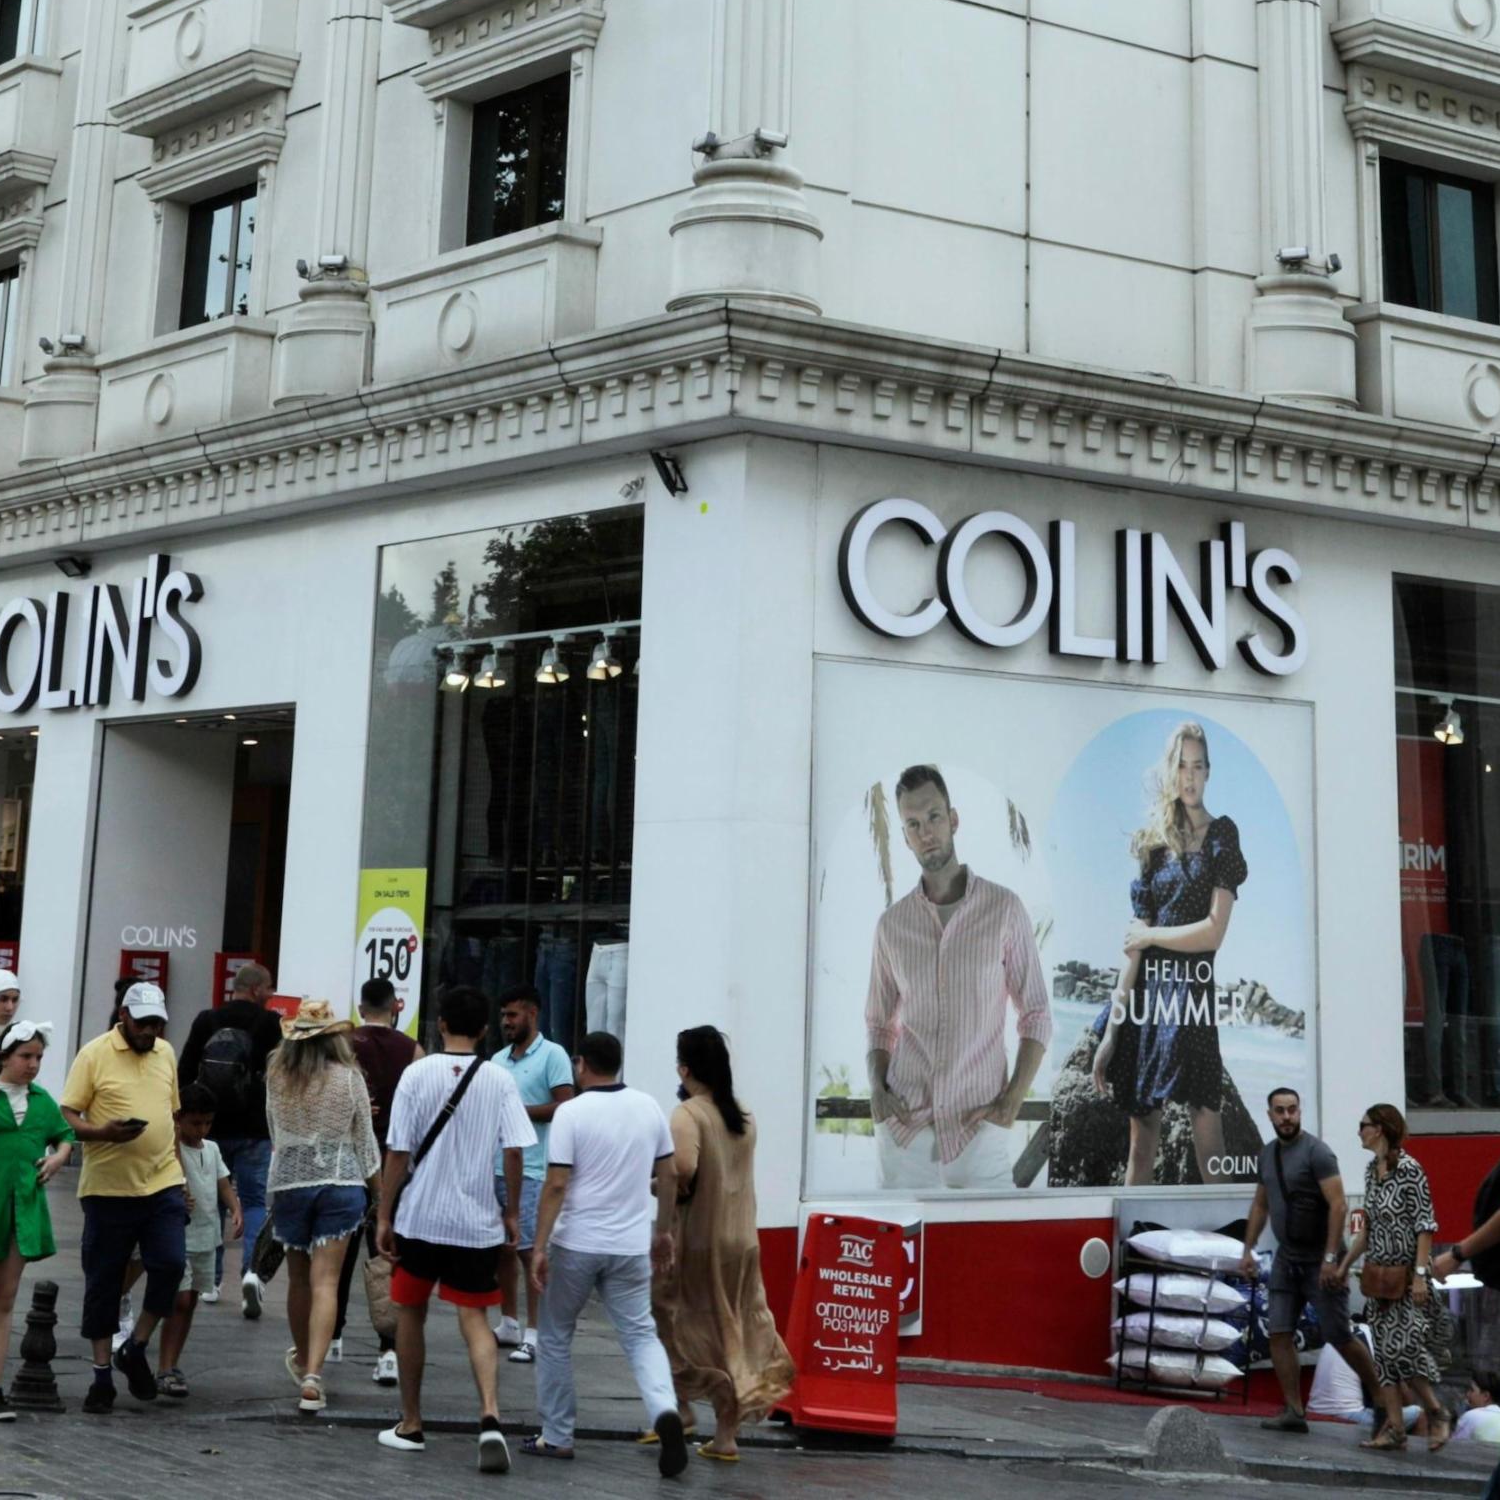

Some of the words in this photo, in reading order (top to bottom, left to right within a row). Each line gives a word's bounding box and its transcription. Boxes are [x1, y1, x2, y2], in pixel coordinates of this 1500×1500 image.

[838, 498, 1307, 676] COLIN'S
[121, 925, 197, 948] COLIN'S
[1145, 959, 1213, 983] HELLO
[1110, 989, 1247, 1027] SUMMER
[1207, 1156, 1259, 1175] COLIN
[819, 1268, 893, 1288] WHOLESALE
[833, 1284, 875, 1300] RETAIL
[823, 1317, 883, 1336] РОЗНИЦУ
